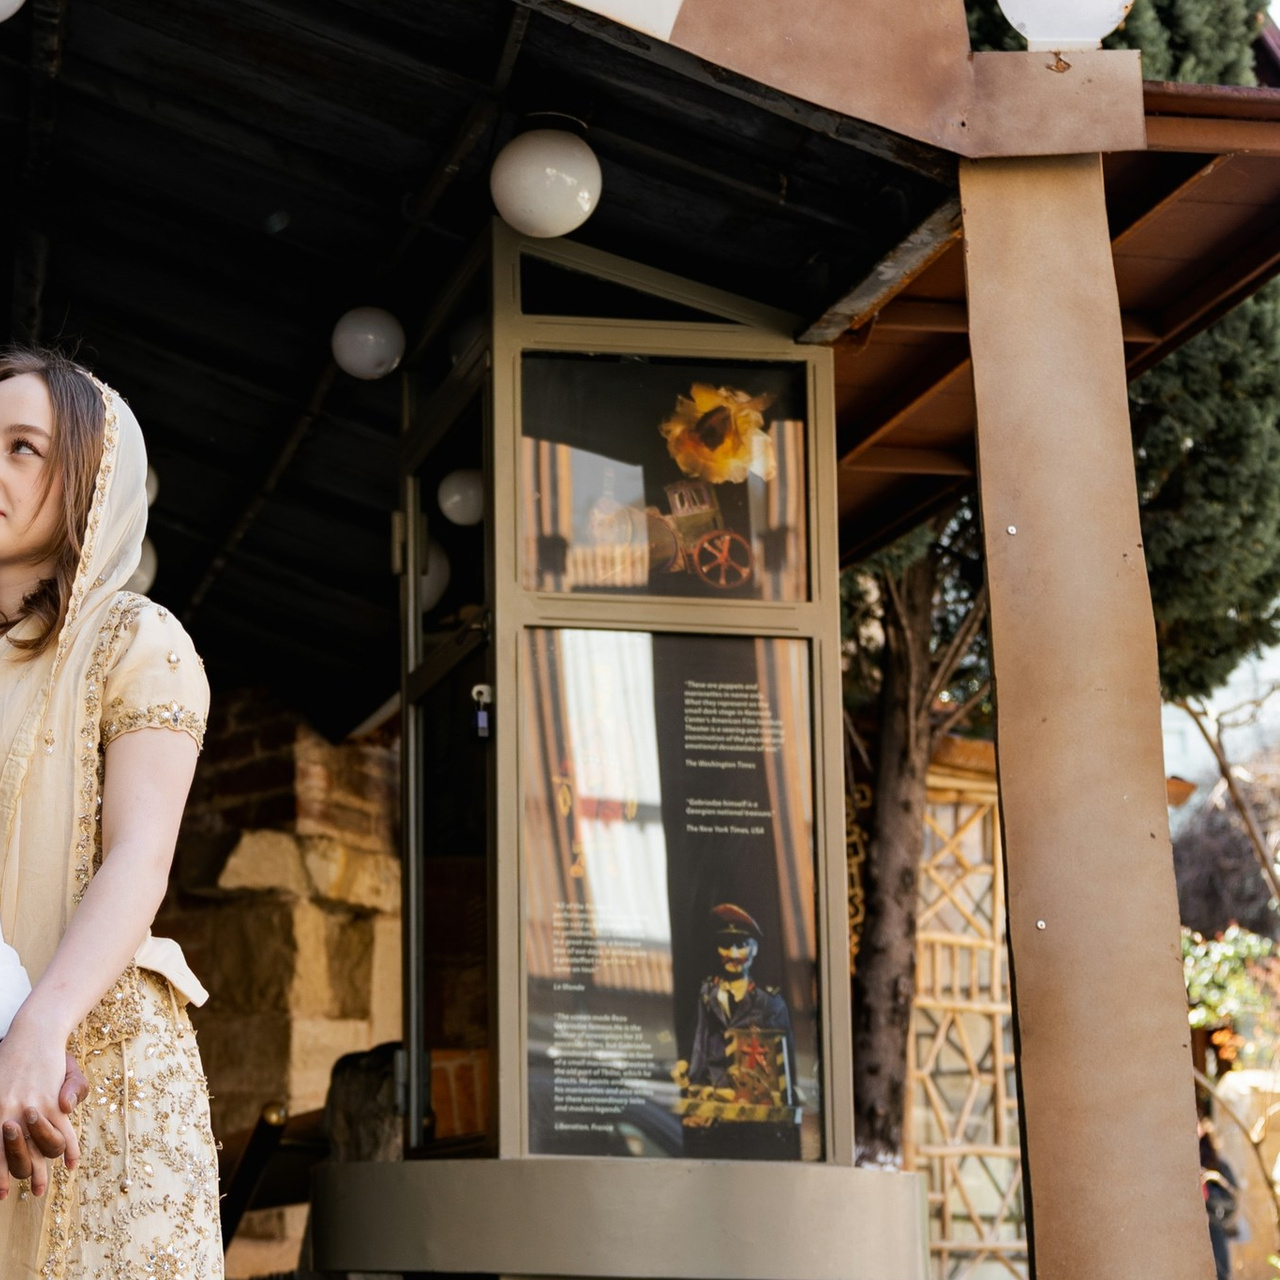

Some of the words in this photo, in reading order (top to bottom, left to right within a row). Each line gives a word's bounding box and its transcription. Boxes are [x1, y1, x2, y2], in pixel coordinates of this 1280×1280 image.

[702, 699, 716, 707] they
[719, 709, 735, 717] stage
[698, 760, 736, 769] Washington
[738, 761, 756, 769] Times
[686, 807, 715, 816] Georgian
[686, 824, 698, 832] The
[562, 983, 585, 991] Monde
[630, 1024, 641, 1032] the
[583, 1096, 628, 1105] extraordinary
